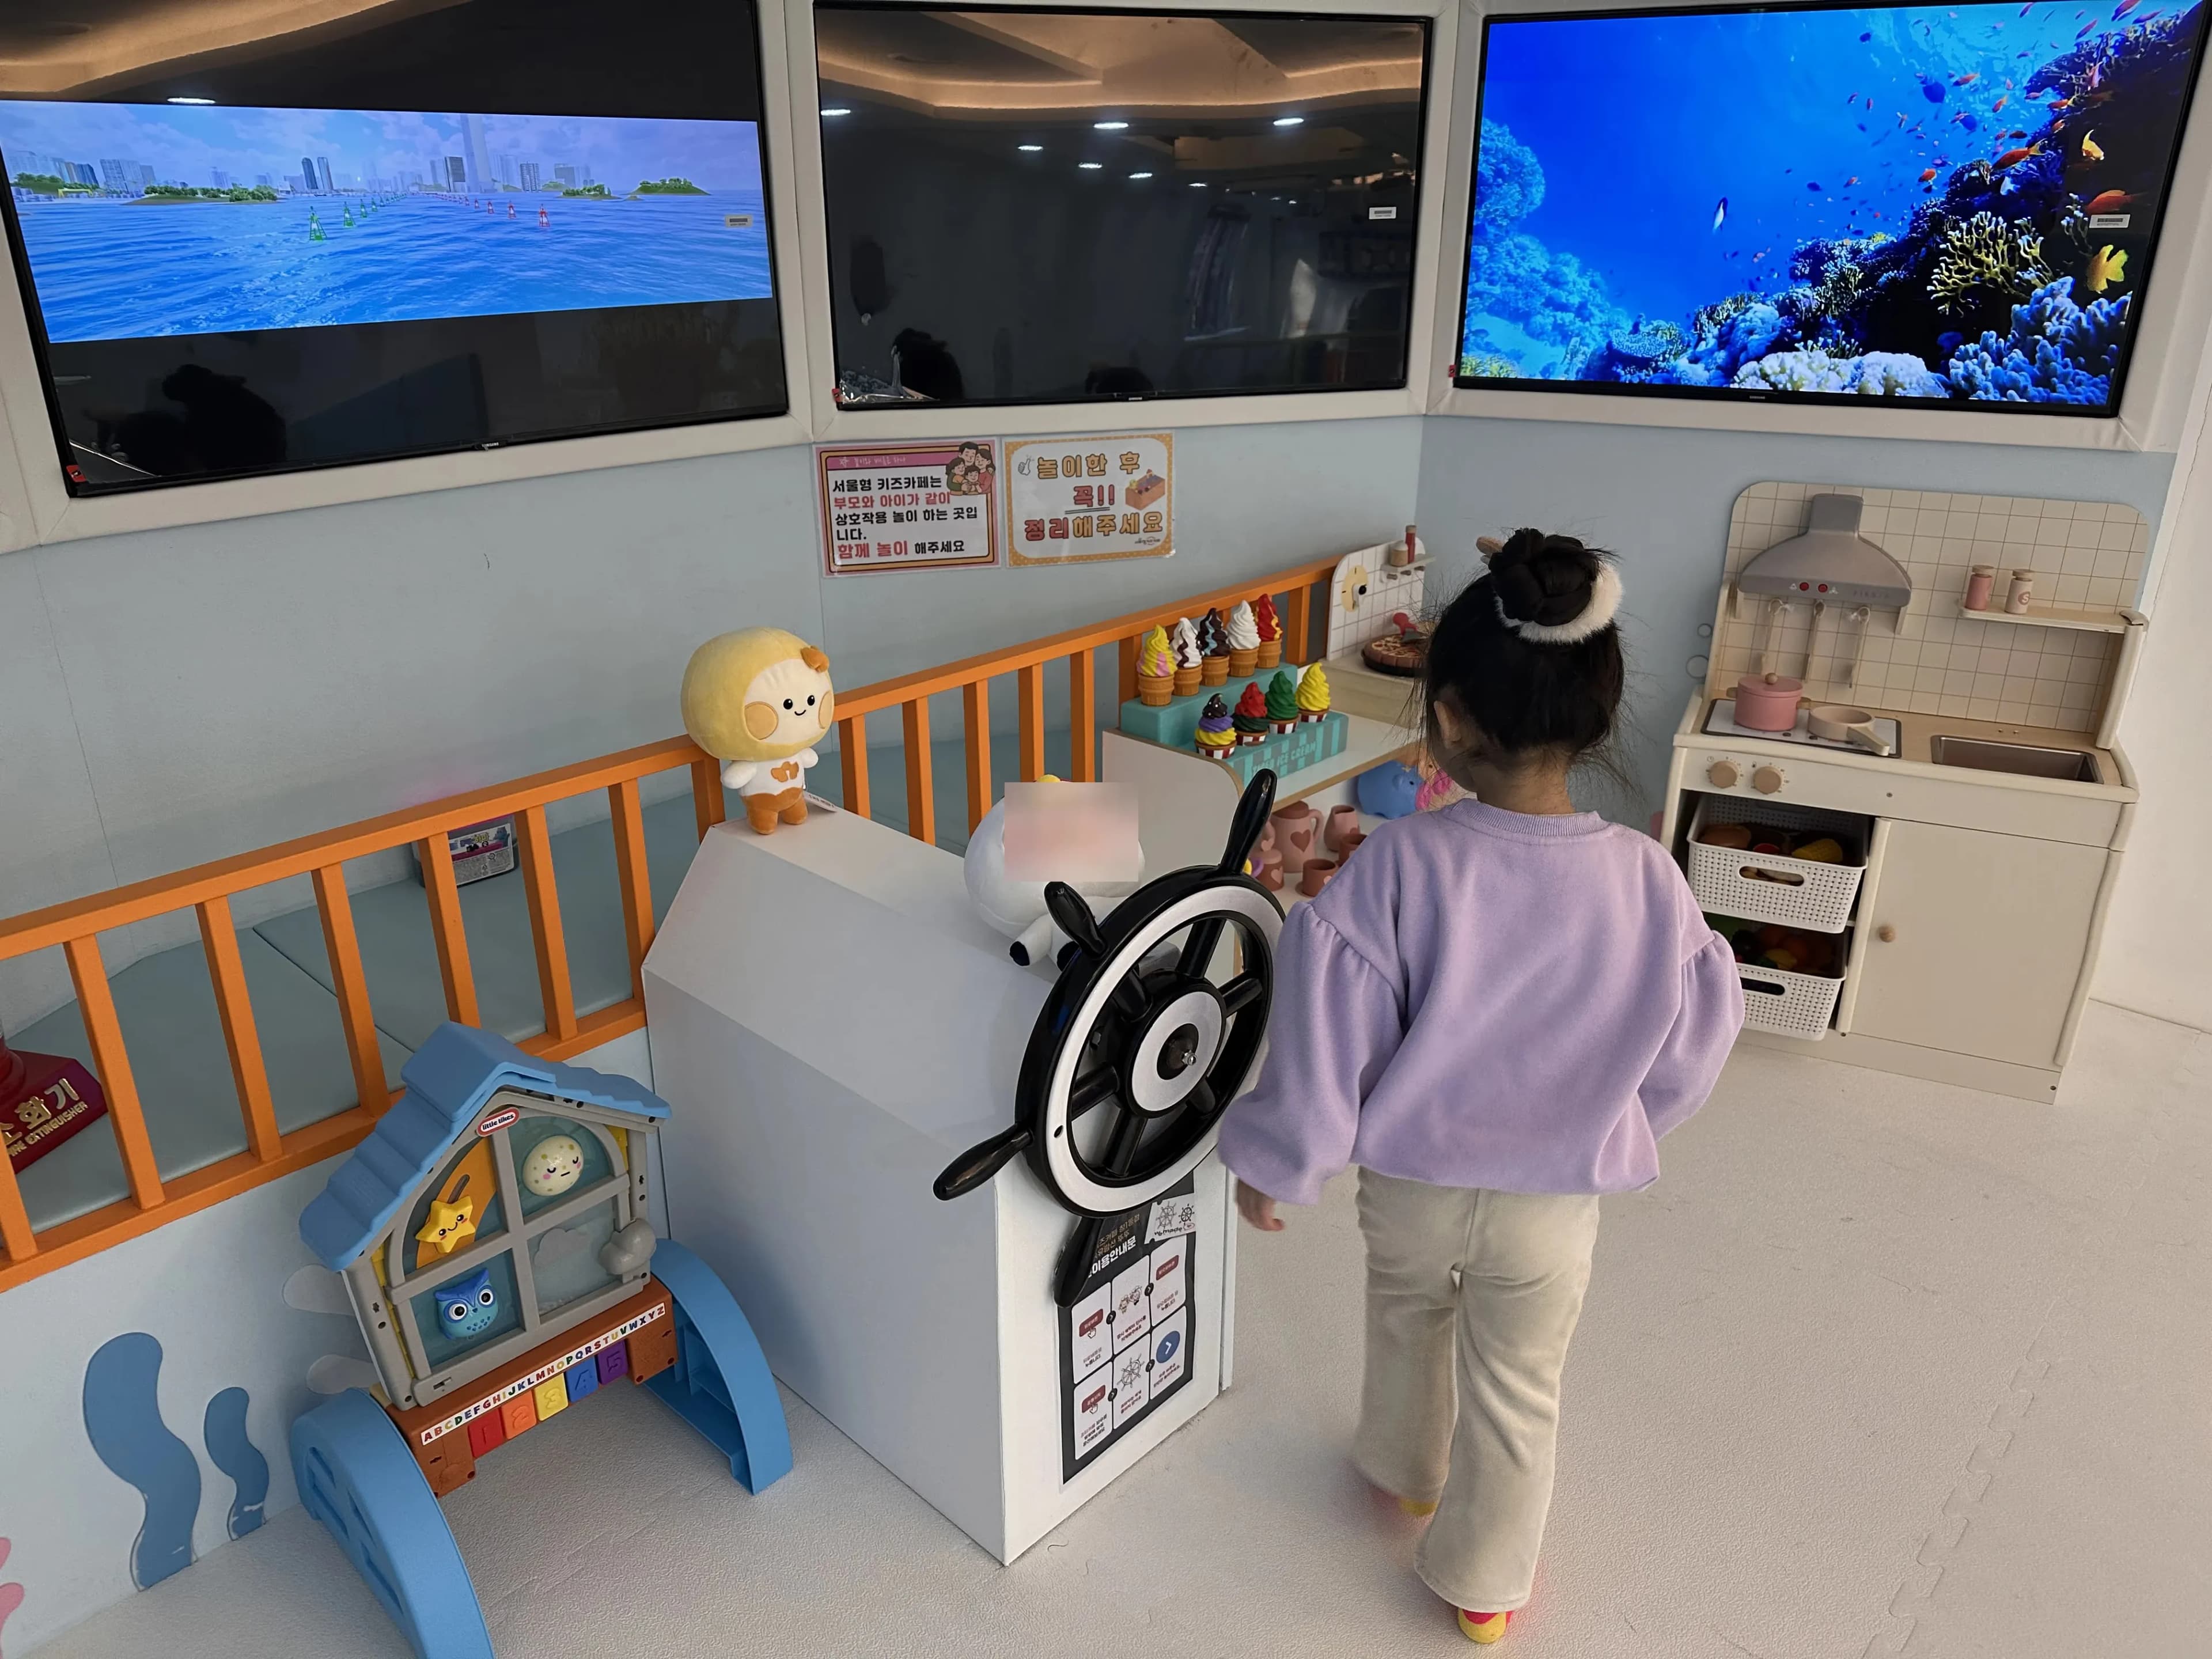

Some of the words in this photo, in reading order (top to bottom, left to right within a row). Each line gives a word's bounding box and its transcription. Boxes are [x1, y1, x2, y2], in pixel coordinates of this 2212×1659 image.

[1037, 453, 1107, 479] 놀이한
[1119, 451, 1140, 475] 후
[833, 478, 872, 493] 서울형
[877, 476, 942, 491] 키즈카페는
[834, 495, 874, 510] 부모와
[880, 493, 920, 507] 아이가
[925, 491, 950, 505] 같이
[1073, 484, 1115, 507] 꼭!!
[835, 511, 887, 526] 상호작용
[893, 510, 918, 523] 놀이
[923, 509, 948, 521] 하는
[953, 506, 978, 520] 곳입
[836, 528, 867, 541] 니다.
[1024, 512, 1162, 541] 정리해주세요
[838, 543, 870, 559] 함께
[877, 540, 908, 556] 놀이
[914, 540, 965, 554] 해주세요
[482, 1120, 497, 1130] little
